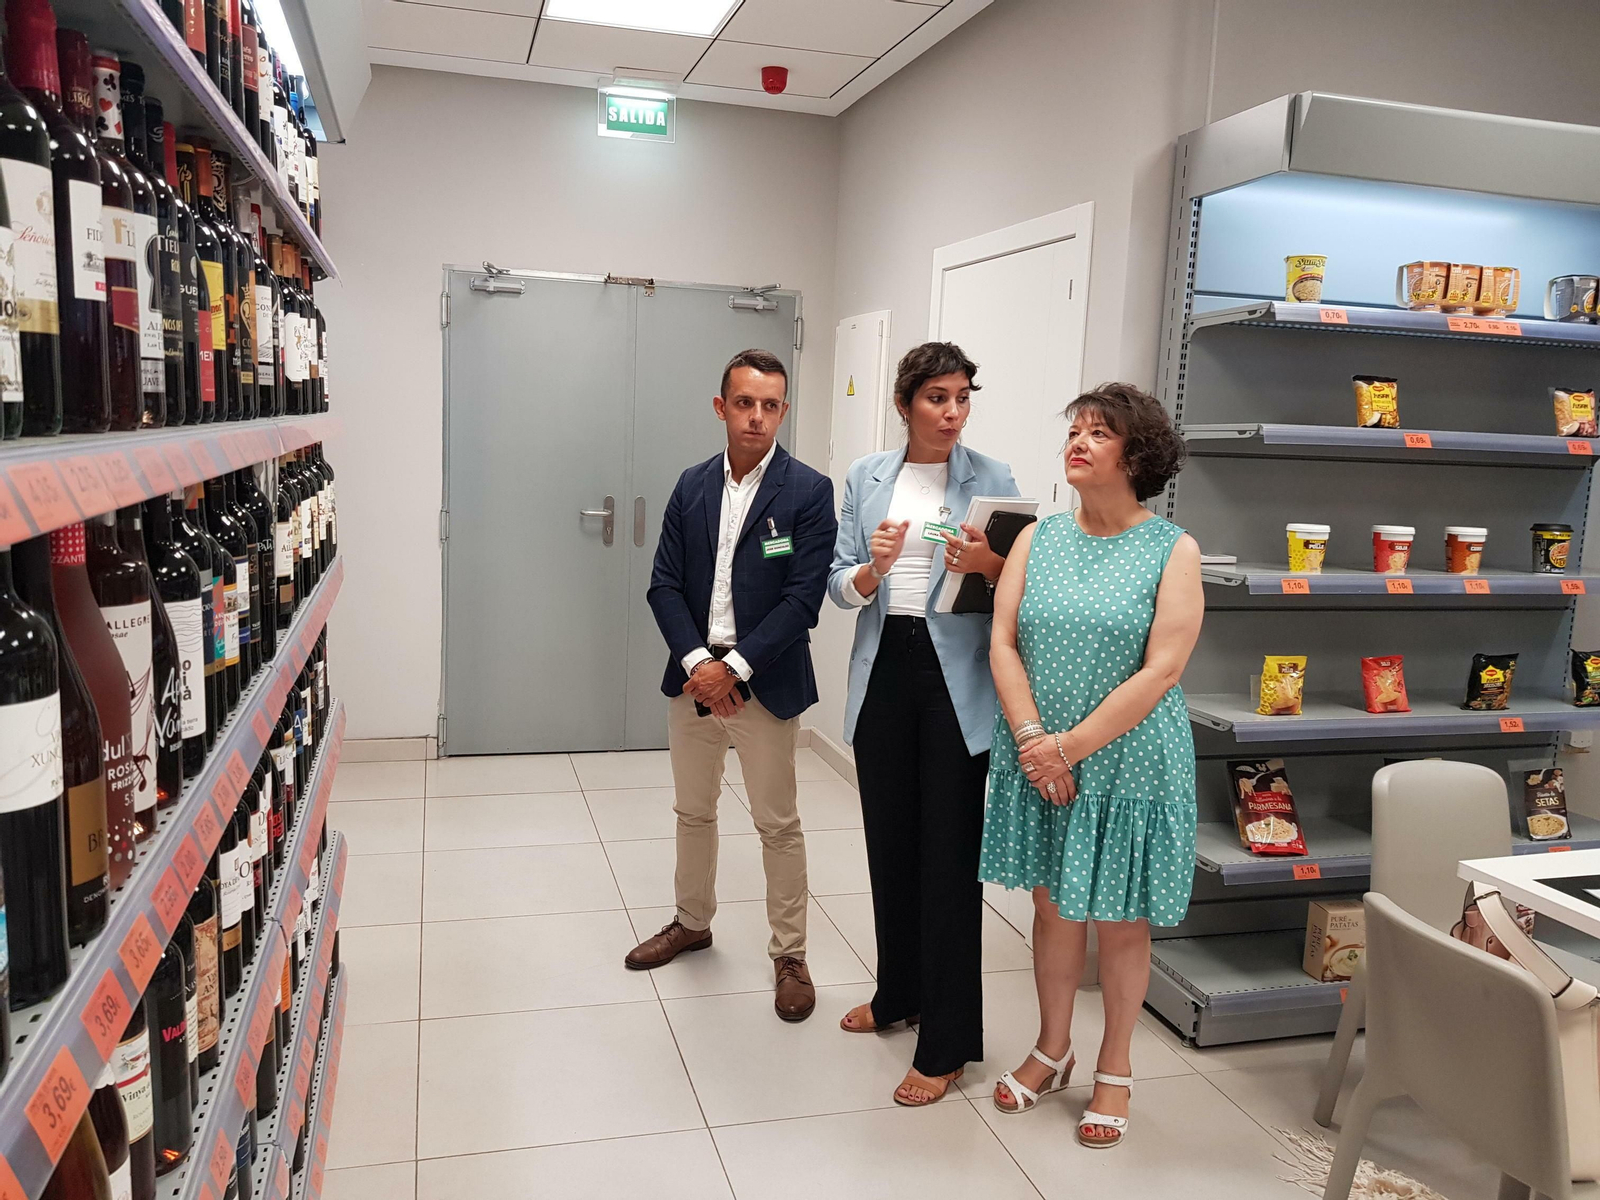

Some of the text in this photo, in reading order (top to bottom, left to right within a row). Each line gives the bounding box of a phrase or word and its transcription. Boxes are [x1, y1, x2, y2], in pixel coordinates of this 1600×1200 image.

[608, 106, 666, 127] SALIDA
[1248, 802, 1293, 811] PARMESANA
[1535, 797, 1560, 807] SETAS
[42, 1076, 77, 1130] 3,69€
